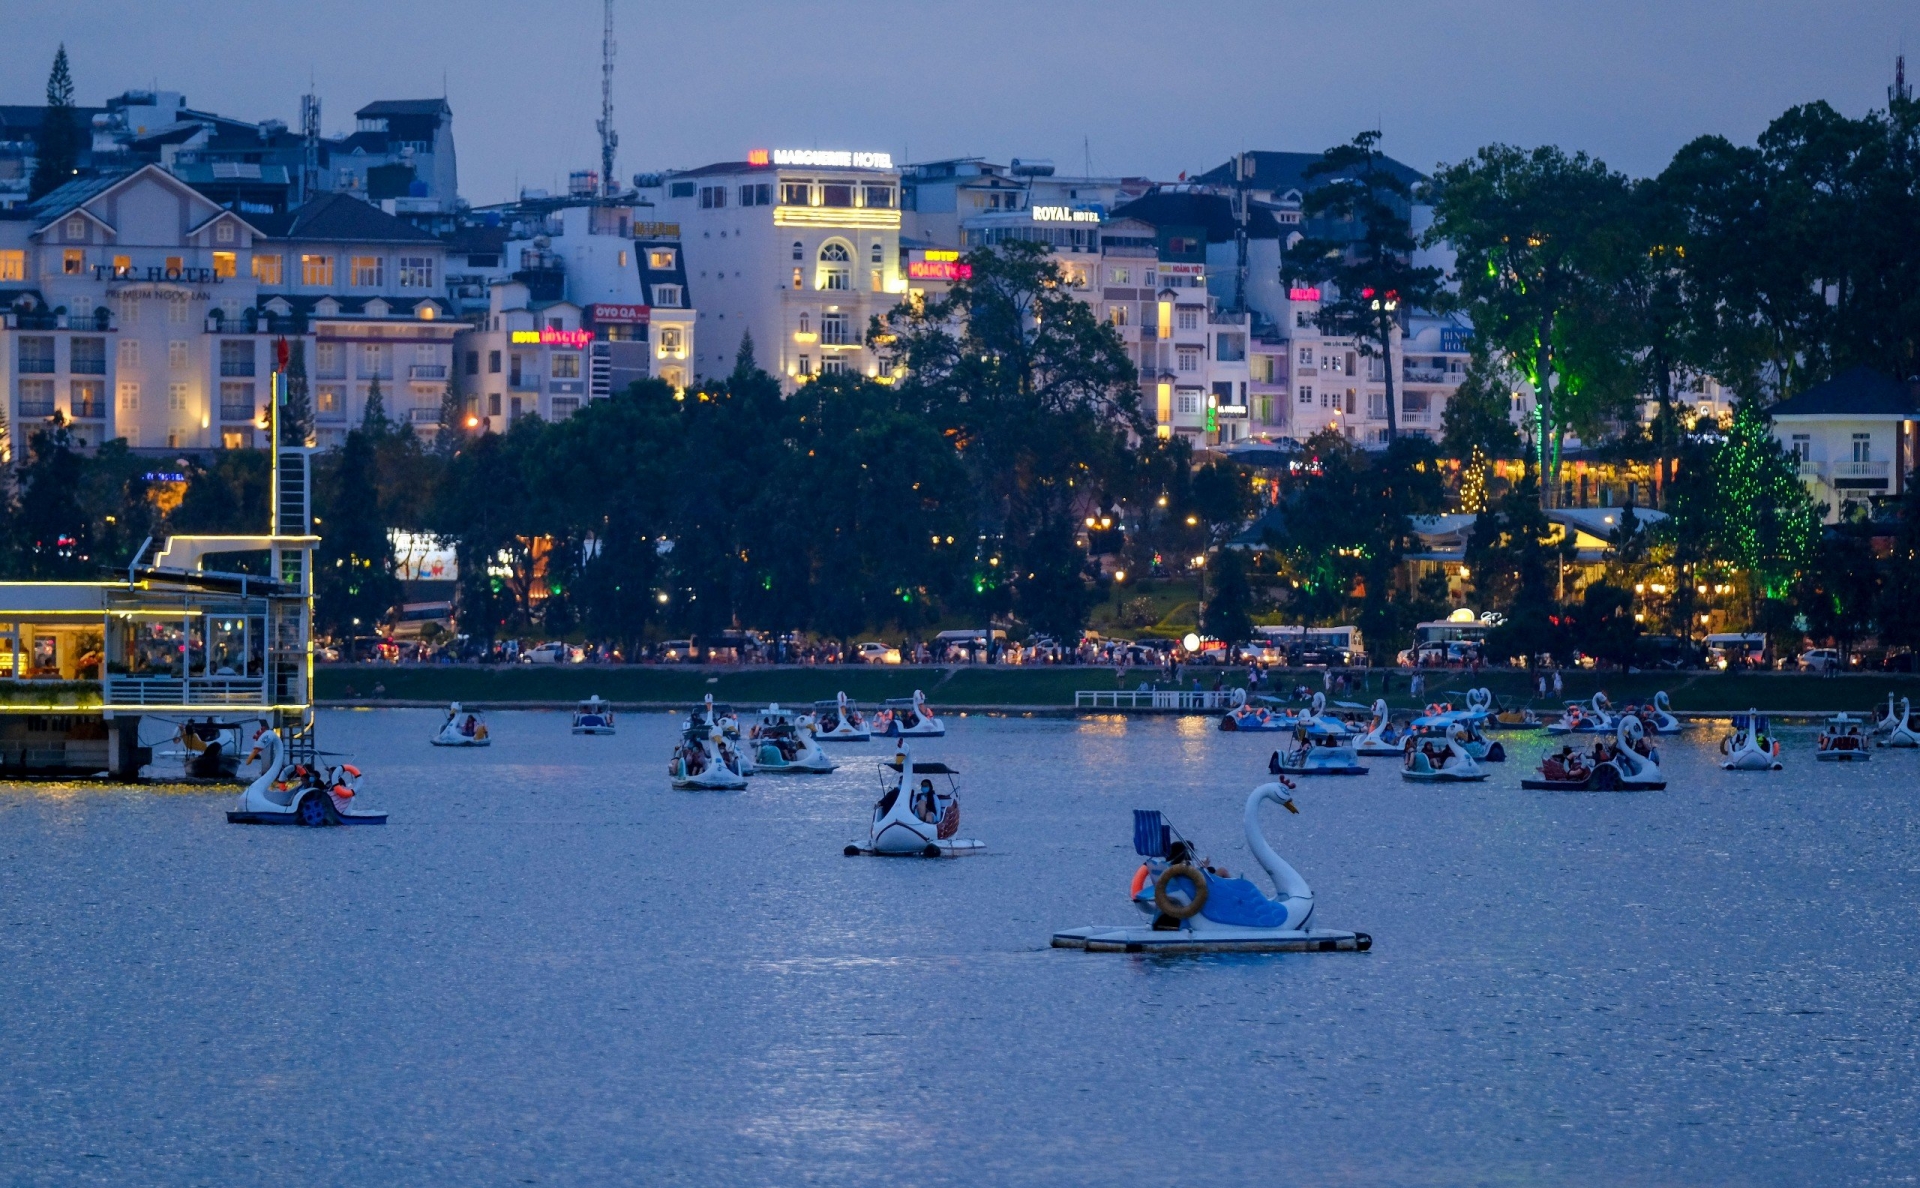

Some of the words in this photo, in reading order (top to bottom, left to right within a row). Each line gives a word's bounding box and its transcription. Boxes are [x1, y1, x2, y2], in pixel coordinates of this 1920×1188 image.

[773, 150, 852, 167] MARGUERITE
[853, 152, 893, 168] HOTEL
[1032, 206, 1072, 221] ROYAL
[1072, 211, 1100, 222] HOTEL
[93, 265, 138, 280] TTC
[147, 266, 224, 283] HOTEL
[105, 289, 151, 299] PREMIUM
[595, 307, 619, 317] OYO
[620, 307, 637, 319] QA
